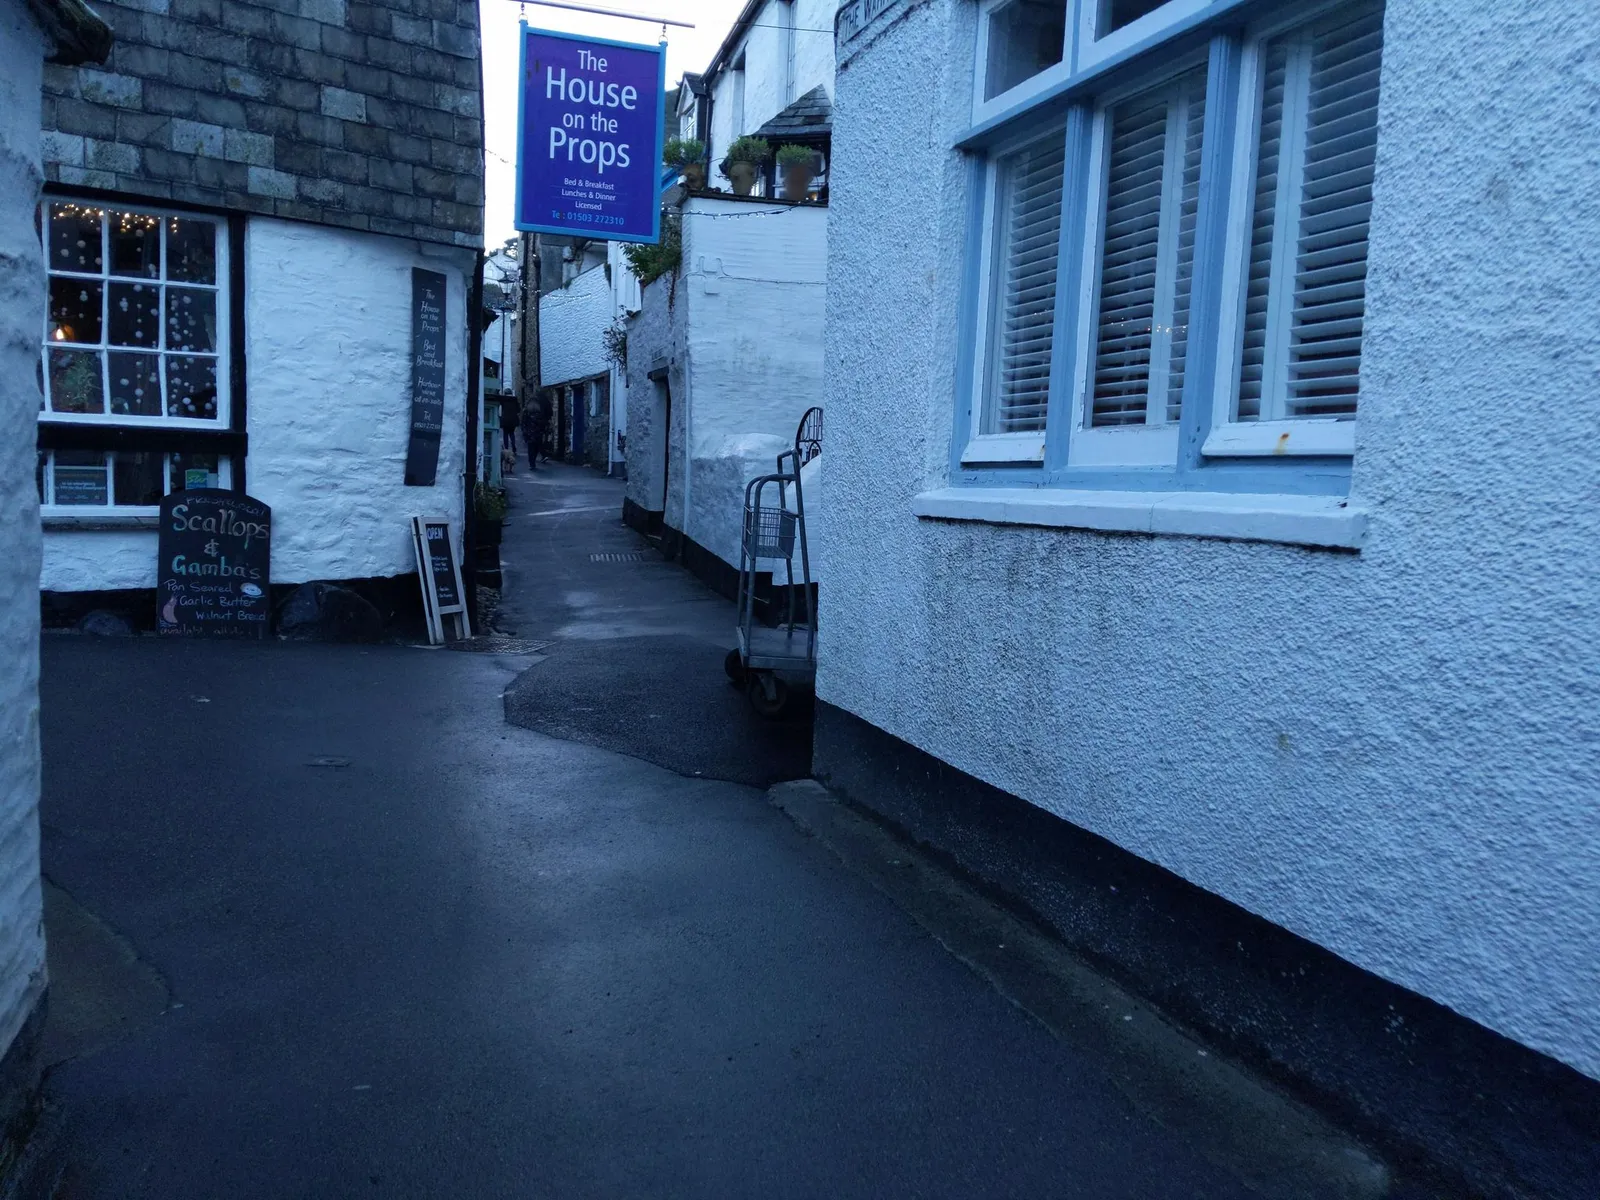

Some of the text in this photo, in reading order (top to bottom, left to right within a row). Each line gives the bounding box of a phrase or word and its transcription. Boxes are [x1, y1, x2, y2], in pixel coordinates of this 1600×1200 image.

[577, 49, 608, 73] The
[546, 66, 638, 110] House
[563, 111, 618, 133] on the
[549, 126, 631, 174] Props
[564, 178, 615, 190] Bed & Breakfast
[561, 188, 616, 201] Lunches & Dinner
[575, 201, 602, 210] Licensed
[567, 211, 592, 222] 01503
[594, 214, 625, 225] 272310
[420, 300, 440, 312] House
[423, 338, 436, 351] Bed
[415, 355, 443, 368] Breakfast
[171, 503, 270, 550] Scallops
[427, 527, 443, 540] OPEN
[204, 538, 220, 558] &
[171, 554, 262, 580] Gamba's
[163, 578, 234, 594] Pan Seared
[179, 595, 257, 608] Garlic Butter
[237, 610, 267, 621] Bread
